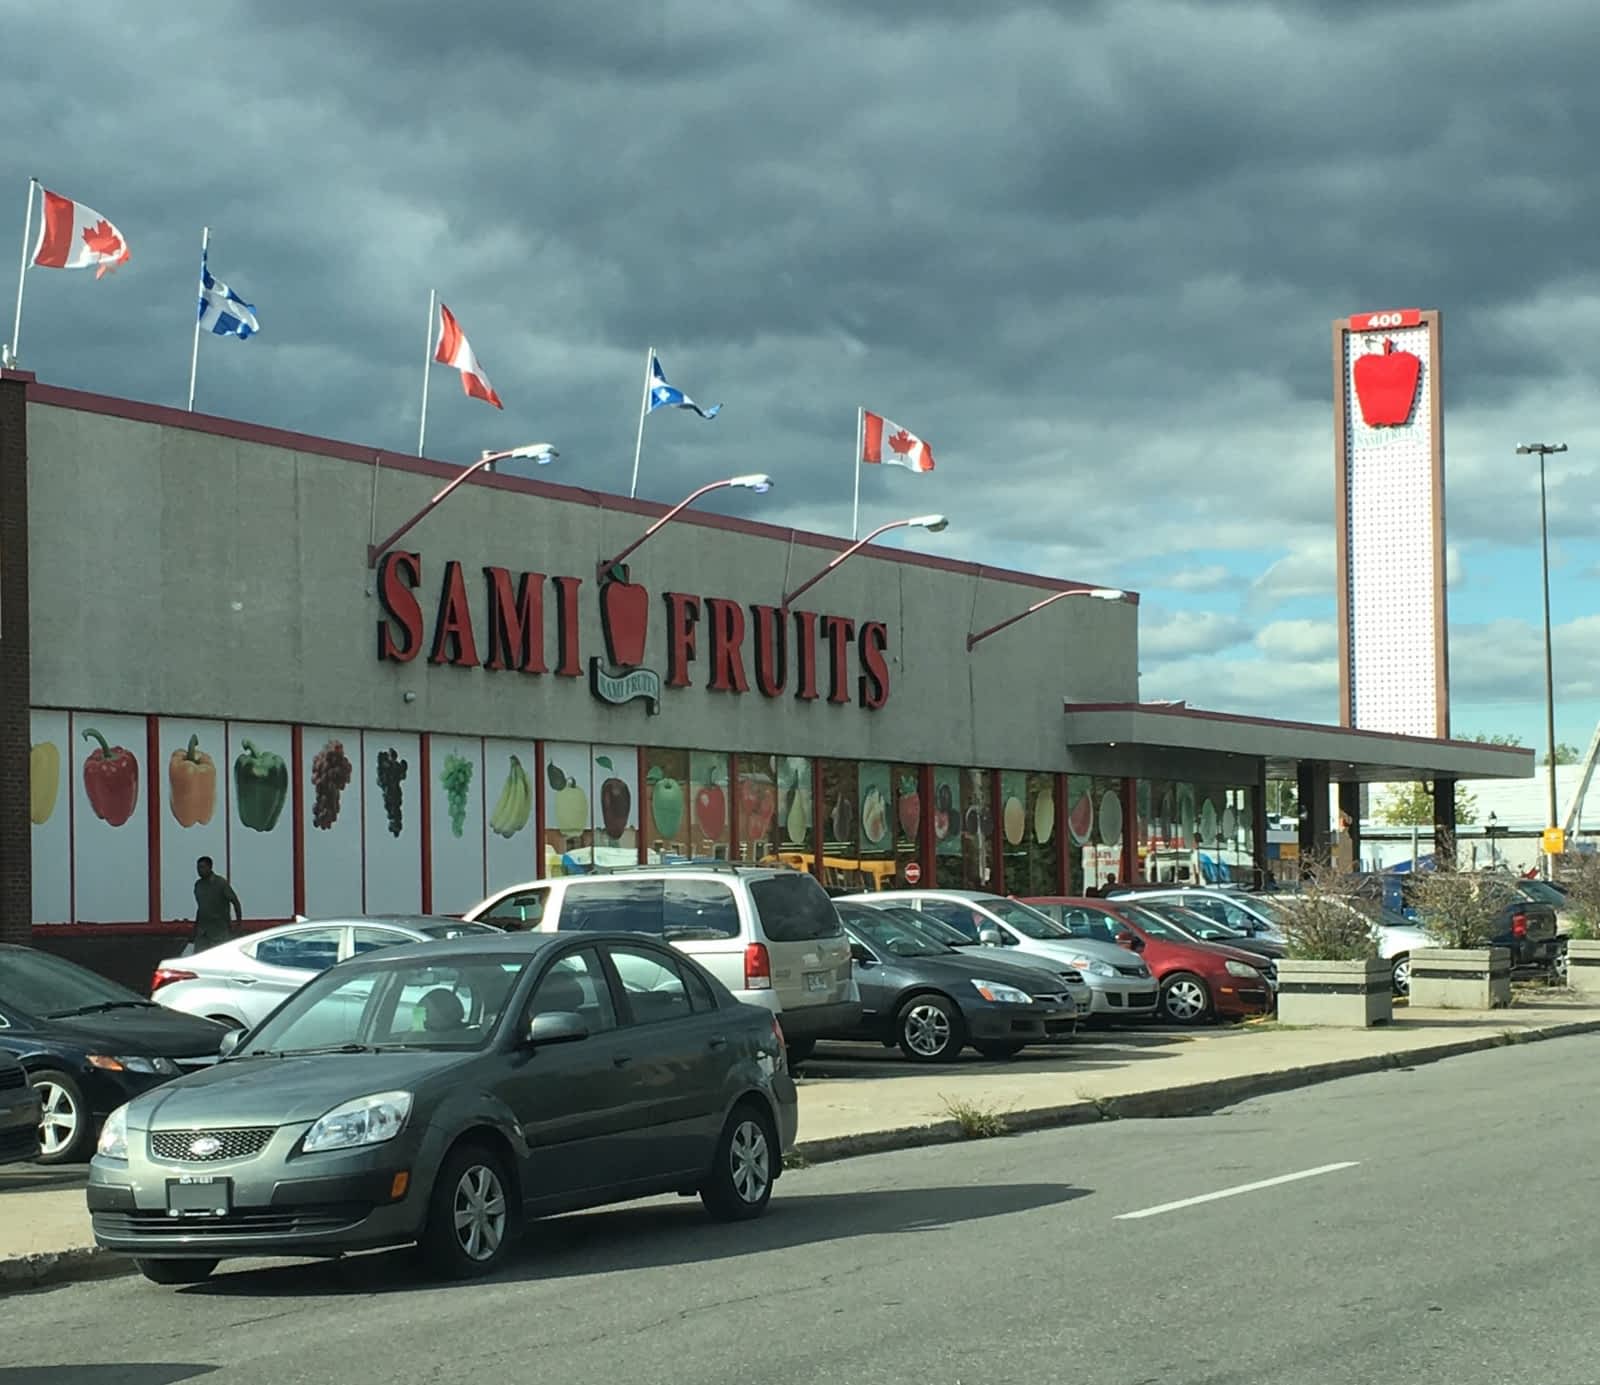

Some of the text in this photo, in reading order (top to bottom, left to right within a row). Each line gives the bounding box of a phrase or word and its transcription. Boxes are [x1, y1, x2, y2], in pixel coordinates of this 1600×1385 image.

[1368, 313, 1402, 327] 400
[377, 550, 888, 710] SAMI FRUITS
